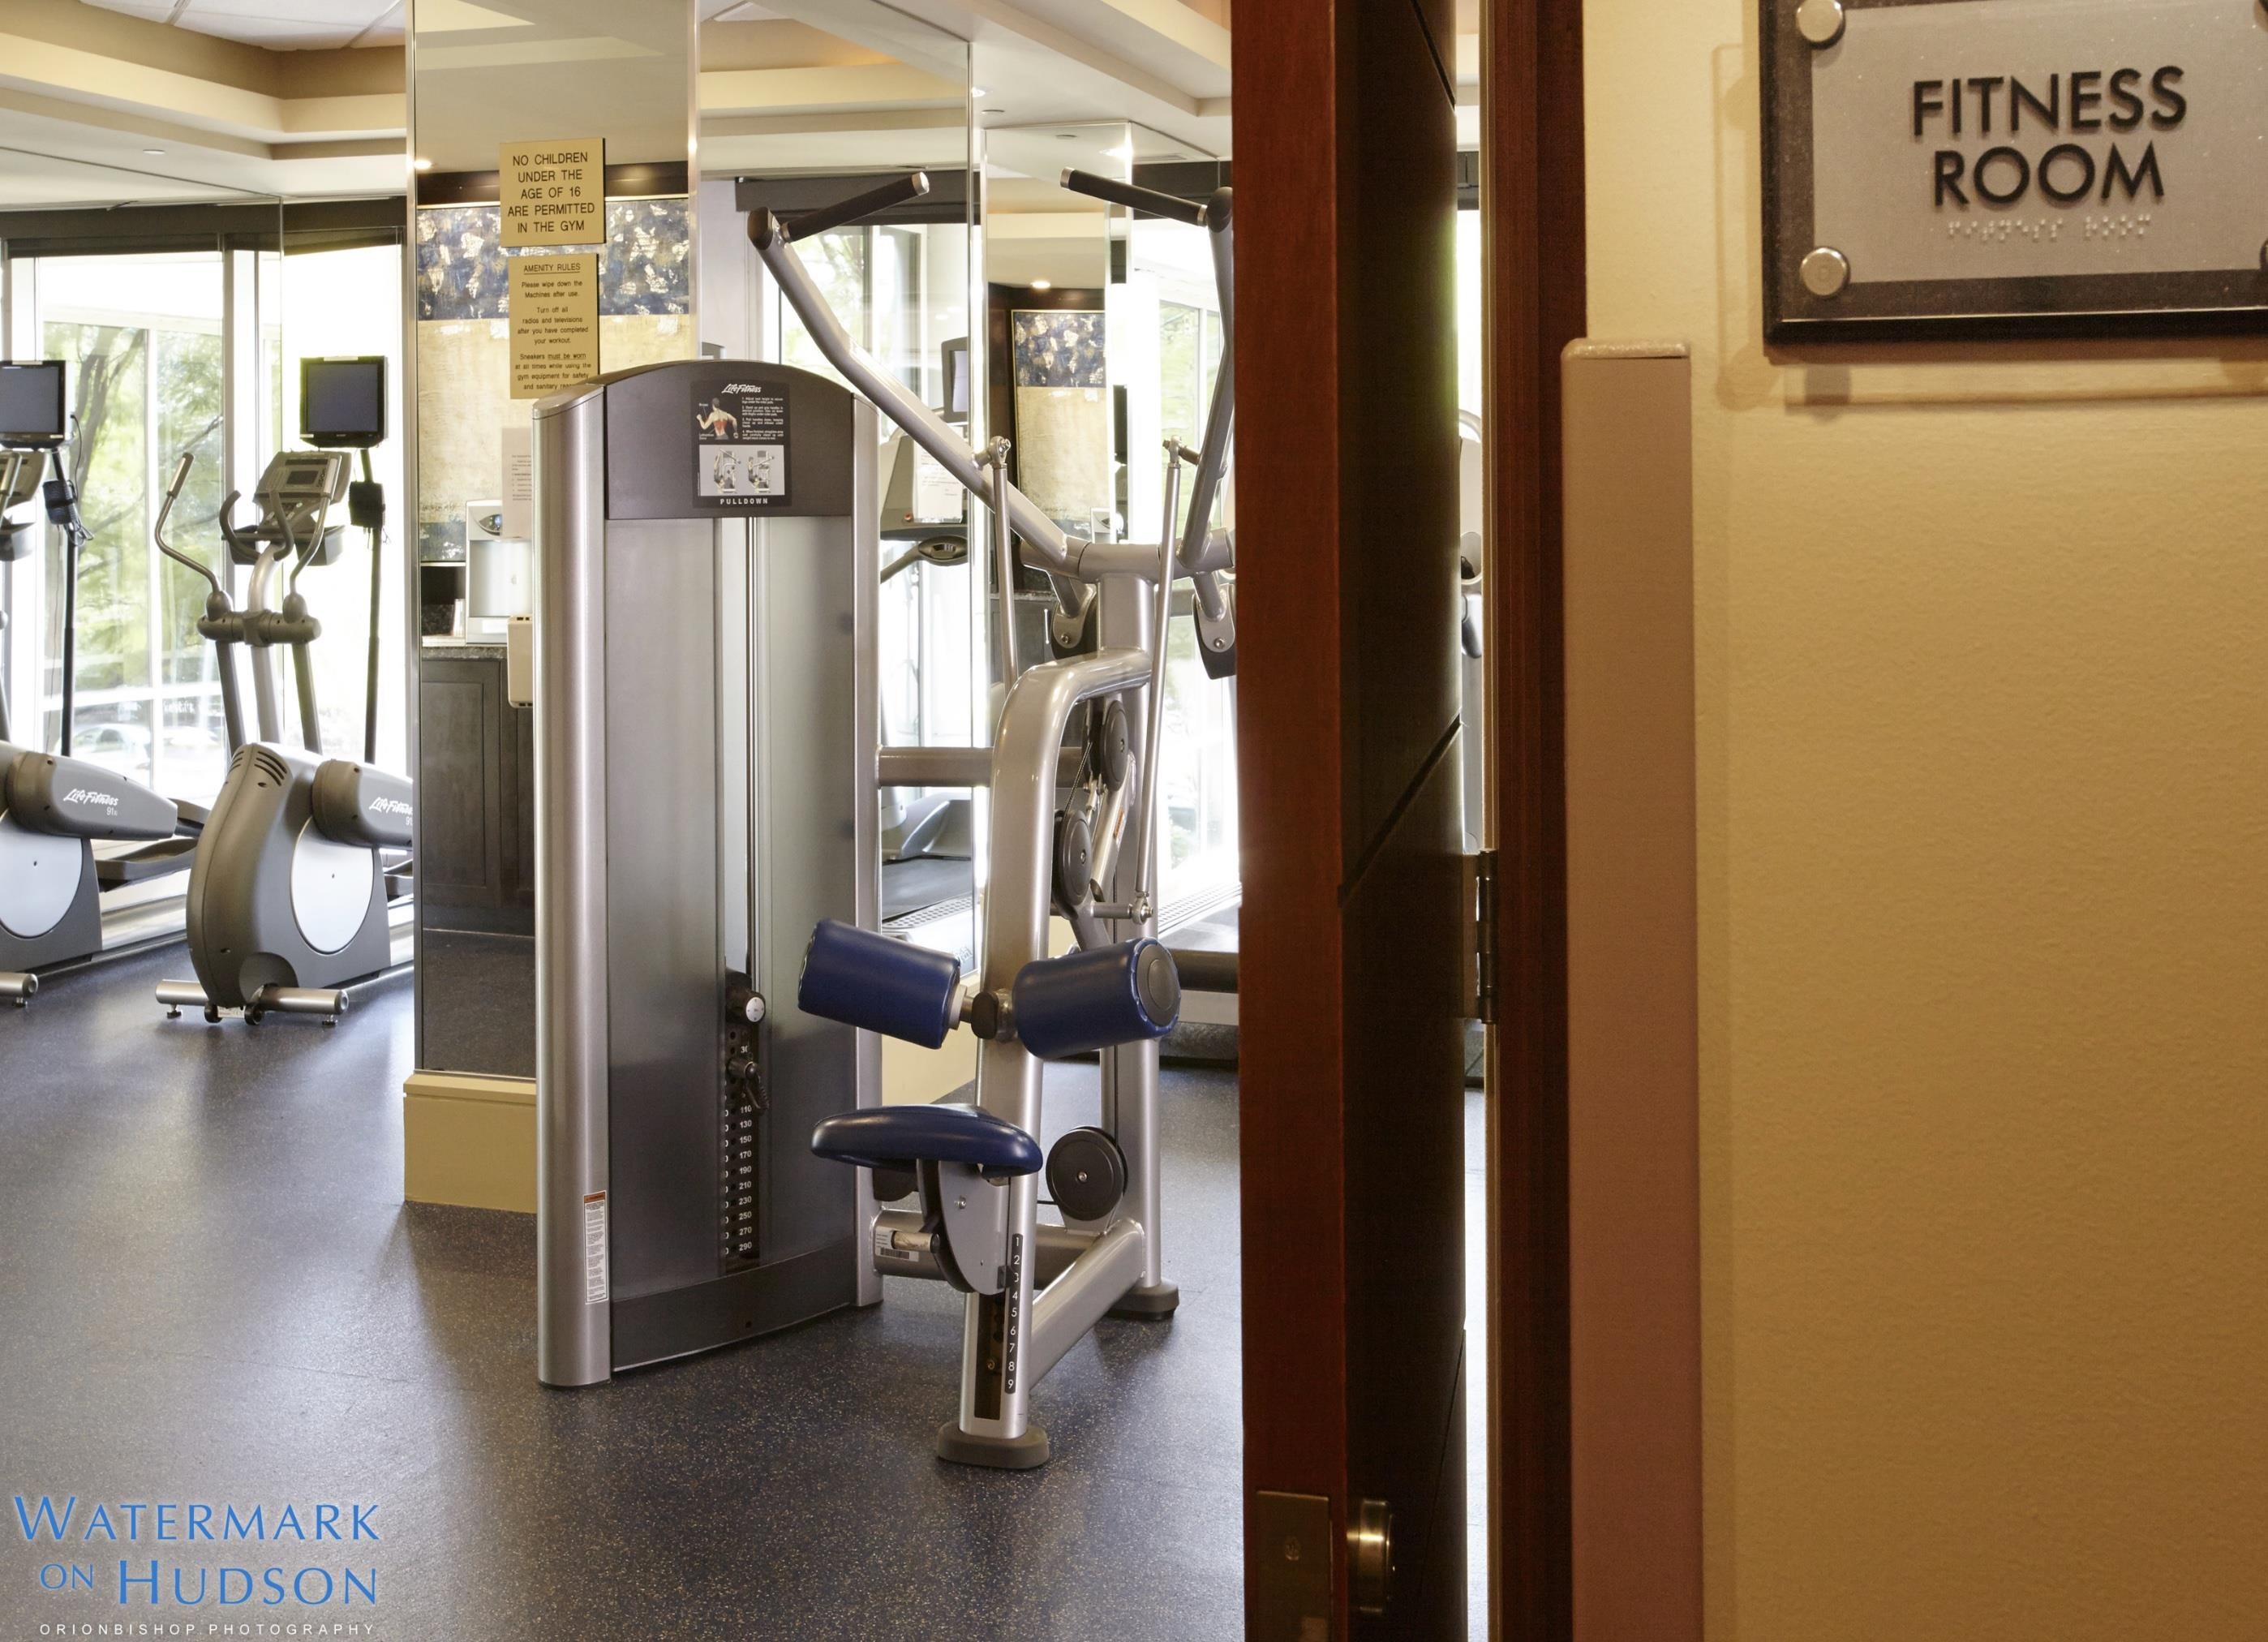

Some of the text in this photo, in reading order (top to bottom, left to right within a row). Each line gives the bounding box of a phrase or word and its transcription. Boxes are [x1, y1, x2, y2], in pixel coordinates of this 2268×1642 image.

[1913, 65, 2188, 137] FITNESS
[513, 152, 588, 166] NO CHILDREN
[518, 169, 583, 183] UNDER THE
[1934, 140, 2165, 207] ROOM
[521, 186, 581, 200] AGE OF 16
[508, 203, 595, 217] ARE PERMITTED
[518, 220, 585, 234] IN THE GYM
[523, 263, 581, 273] AMENITY RULES
[740, 1105, 752, 1114] 110
[739, 1120, 752, 1128] 130
[739, 1135, 752, 1144] 150
[739, 1150, 752, 1159] 170
[739, 1166, 752, 1175] 190
[739, 1181, 752, 1190] 210
[738, 1196, 752, 1206] 230
[738, 1211, 752, 1221] 250
[739, 1227, 752, 1236] 270
[739, 1241, 752, 1252] 290
[1013, 1255, 1020, 1265] 2
[1012, 1291, 1018, 1300] 4
[1011, 1308, 1017, 1317] 5
[1010, 1326, 1016, 1335] 6
[1009, 1343, 1016, 1353] 7
[1008, 1361, 1015, 1371] 8
[1007, 1379, 1014, 1389] 9
